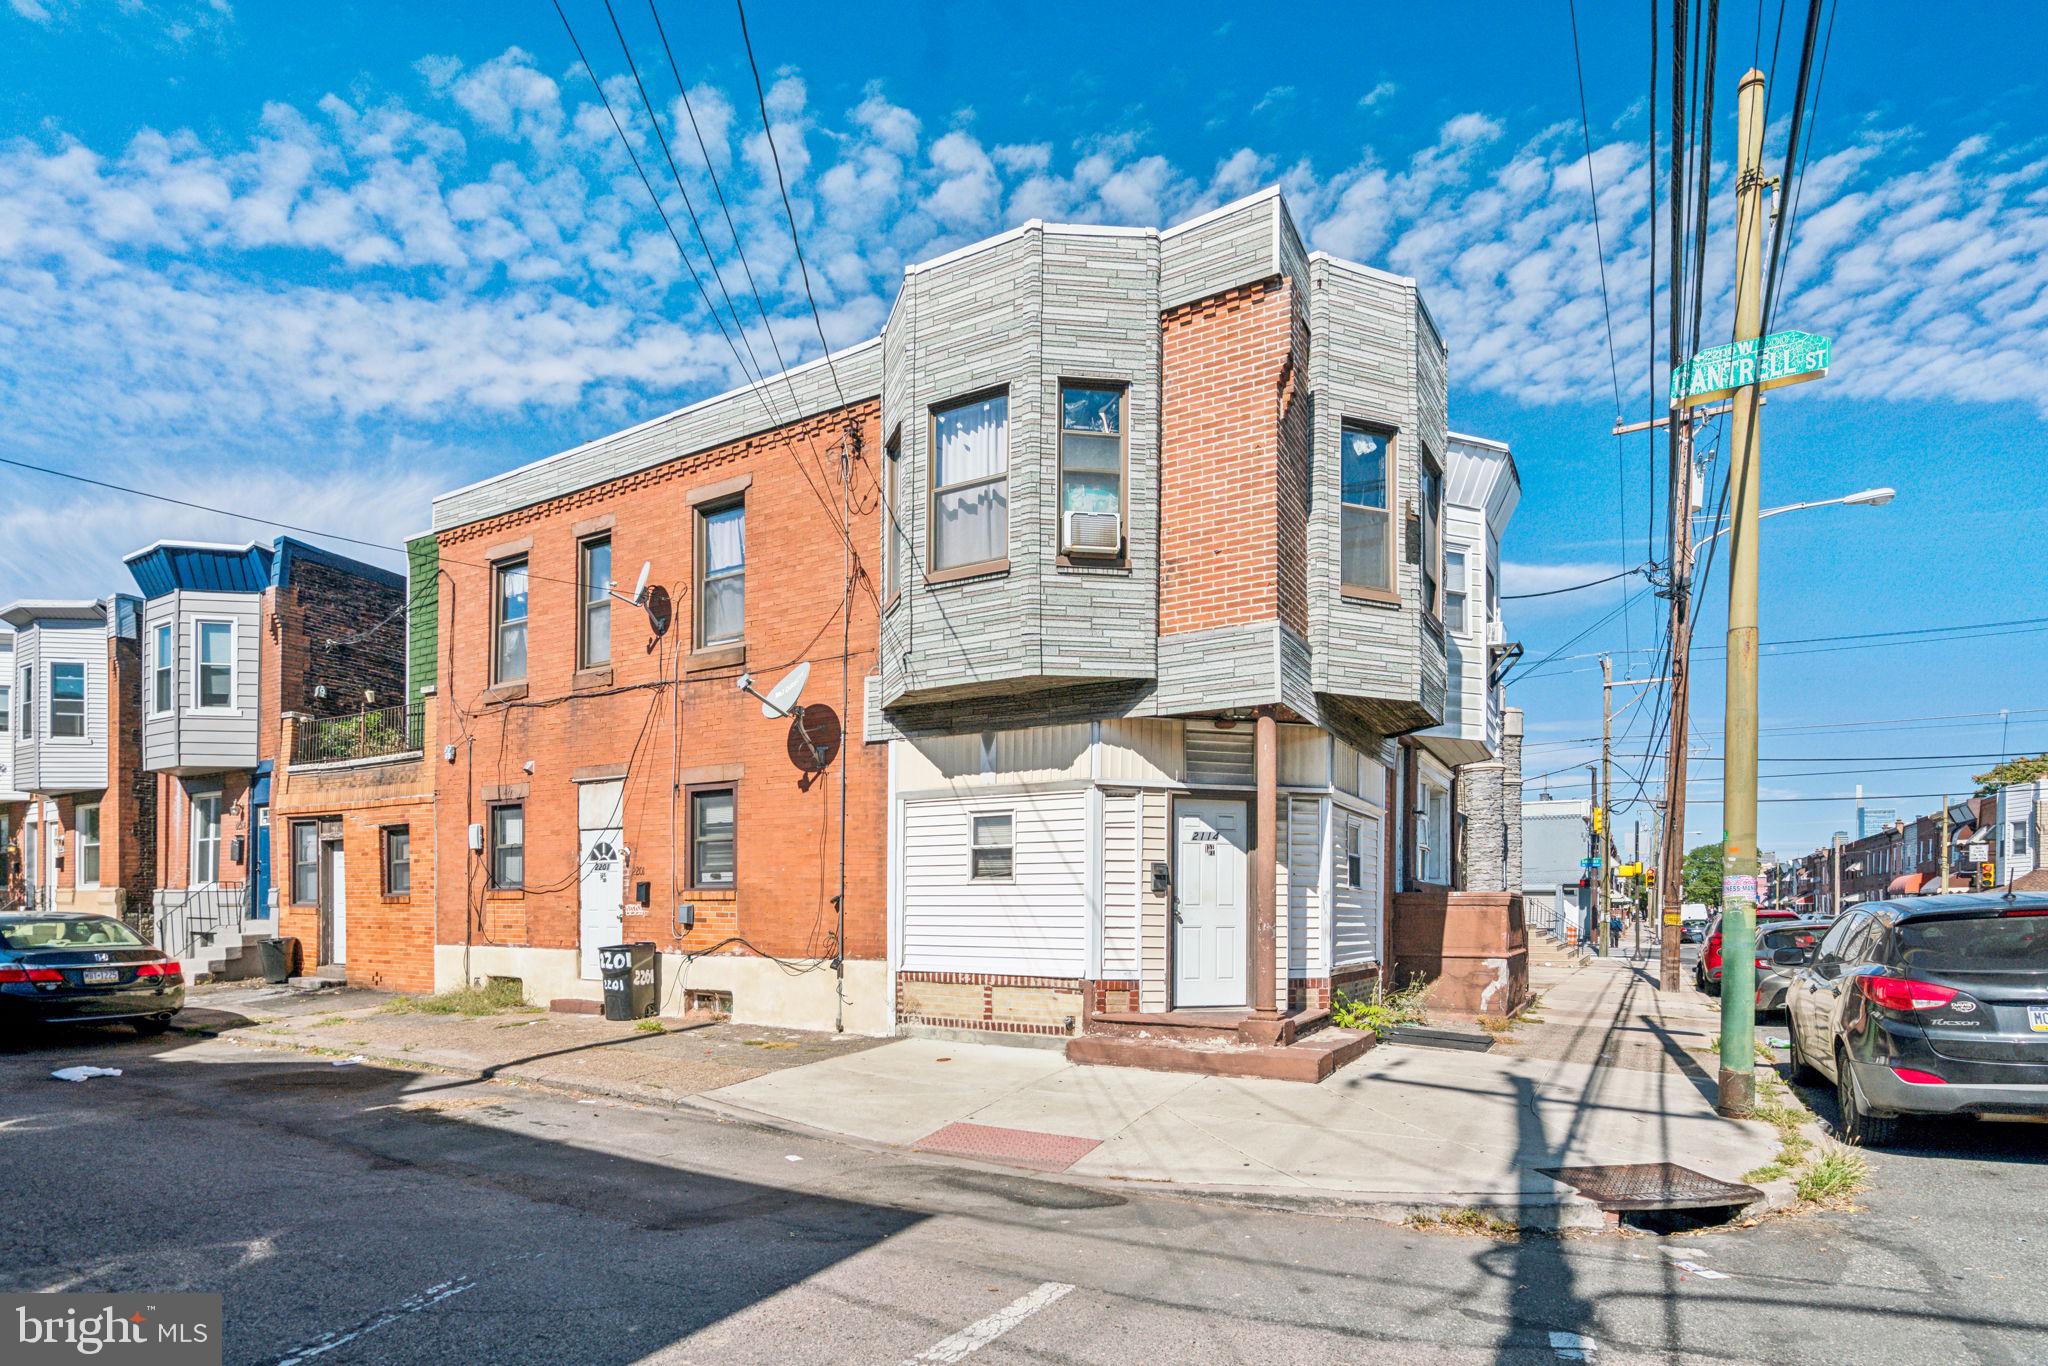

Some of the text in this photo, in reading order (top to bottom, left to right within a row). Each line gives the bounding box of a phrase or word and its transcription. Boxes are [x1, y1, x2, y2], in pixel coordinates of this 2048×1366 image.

[1738, 341, 1754, 355] W
[1674, 349, 1825, 397] CANTRELL ST
[1192, 832, 1220, 840] 2114
[595, 863, 610, 871] 2201
